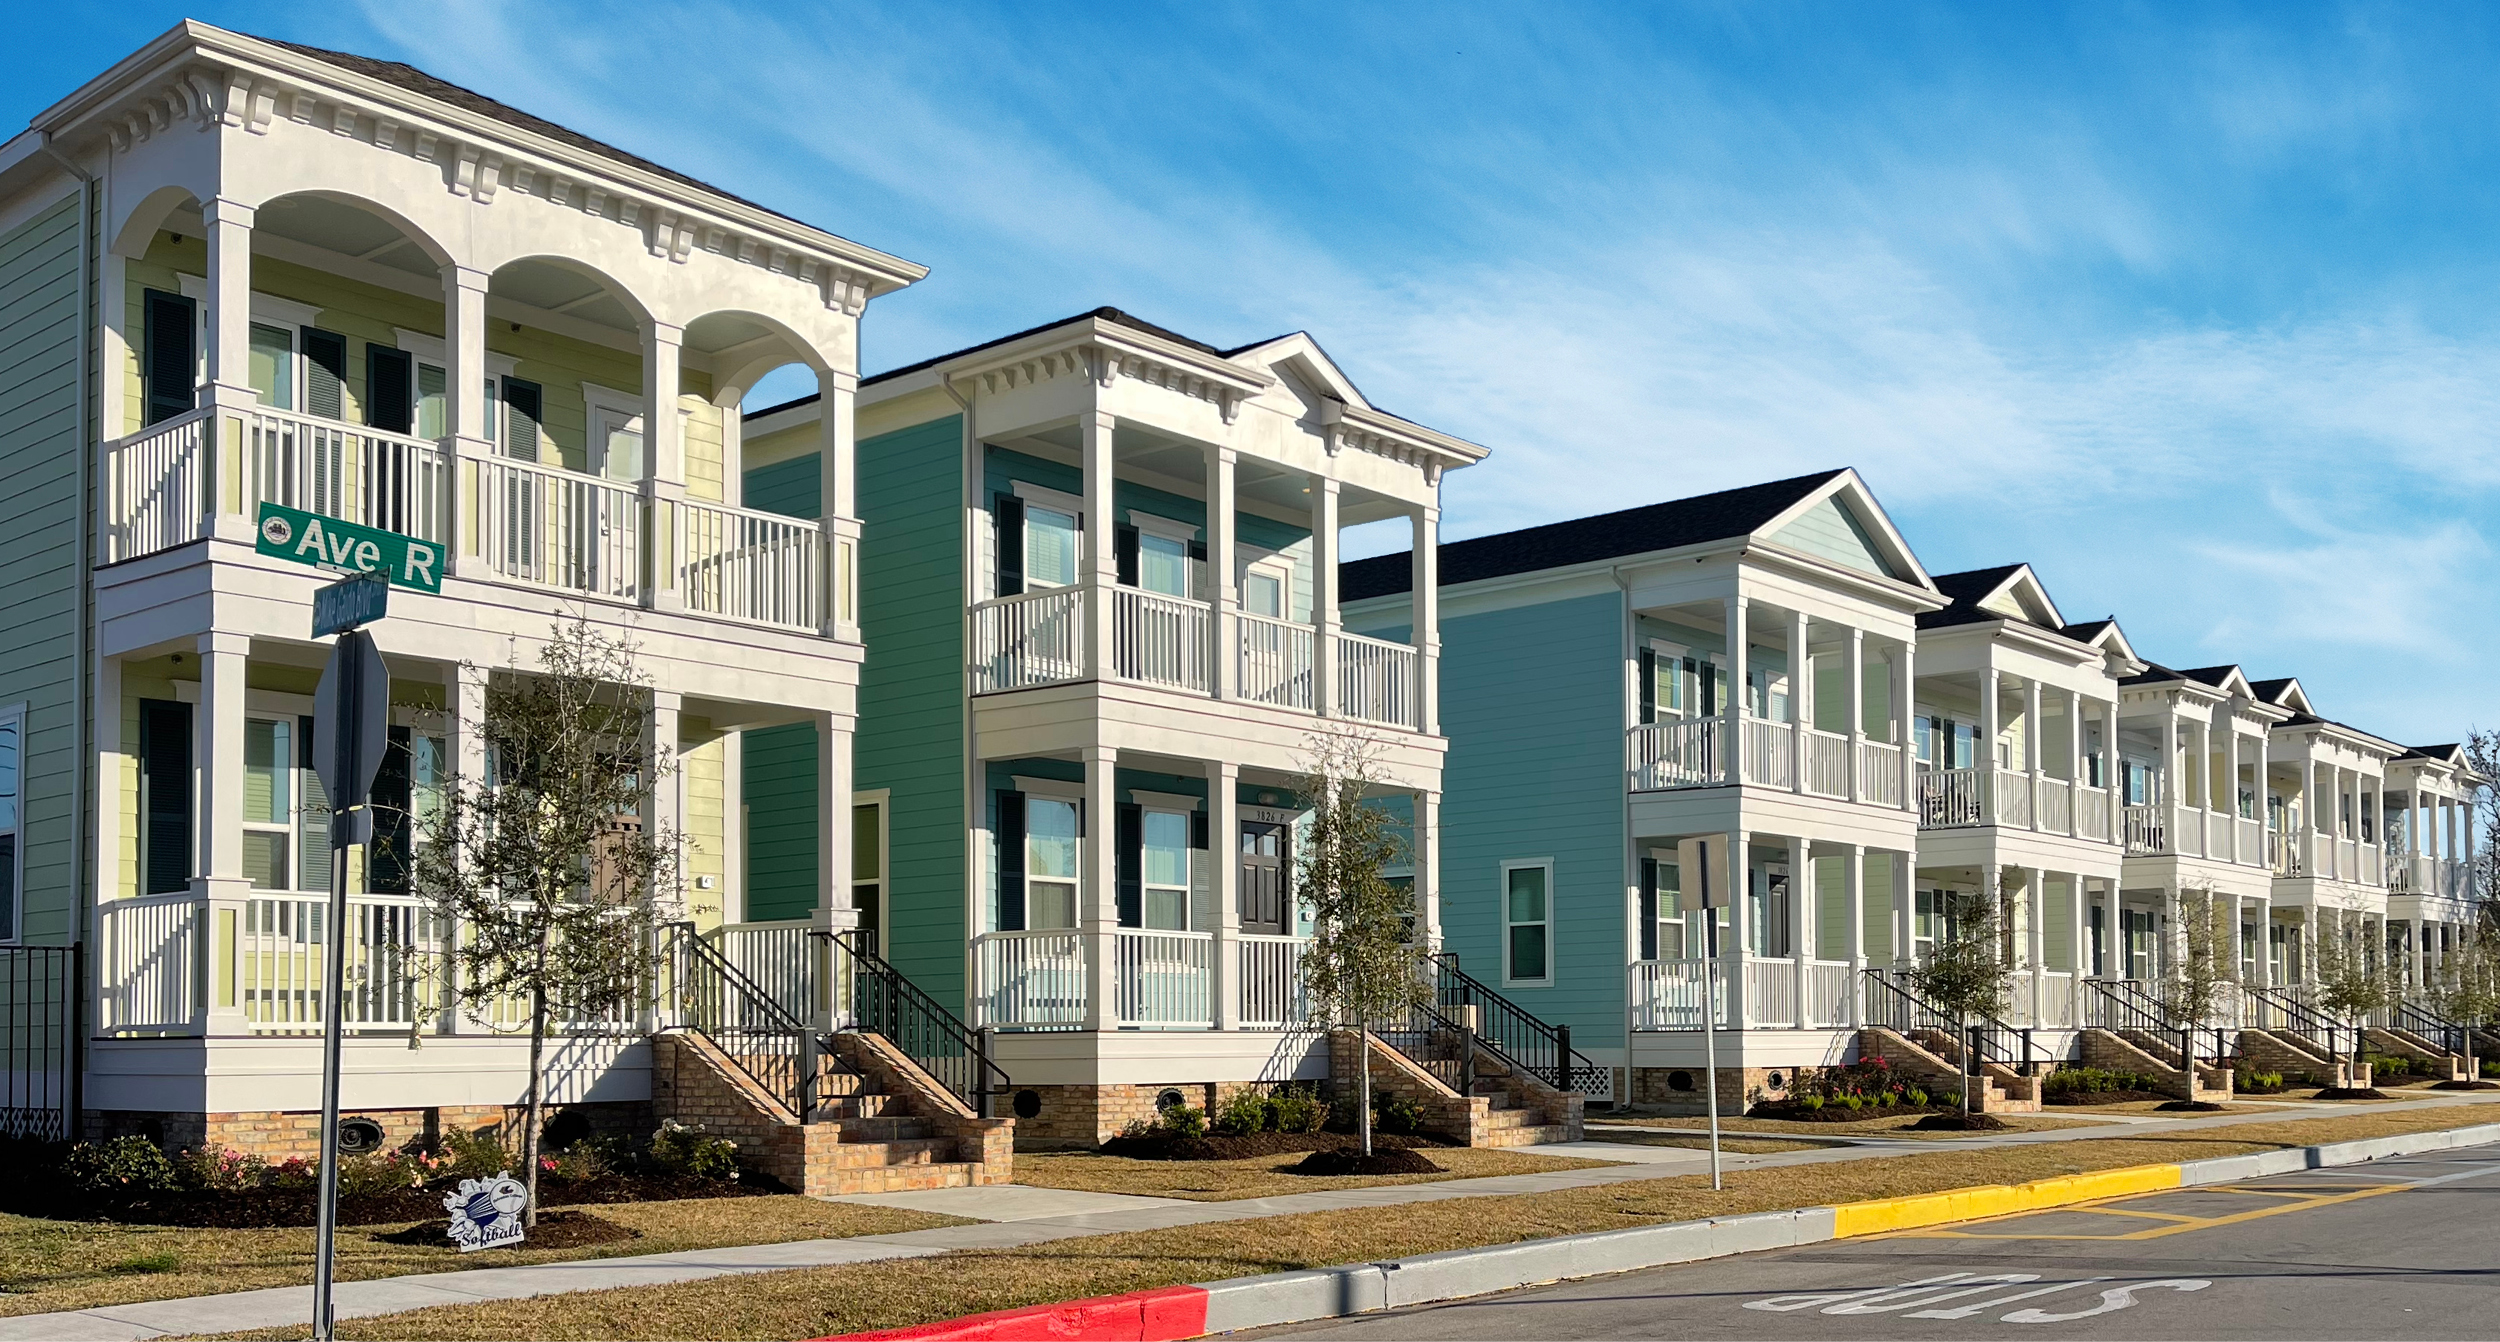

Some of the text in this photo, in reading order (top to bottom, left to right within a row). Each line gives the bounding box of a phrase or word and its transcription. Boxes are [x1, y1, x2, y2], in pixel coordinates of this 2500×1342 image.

[295, 518, 381, 572] Ave
[404, 541, 435, 586] R
[1256, 810, 1275, 822] 3826
[462, 1222, 521, 1247] Softball
[1741, 1272, 2212, 1324] STOP
